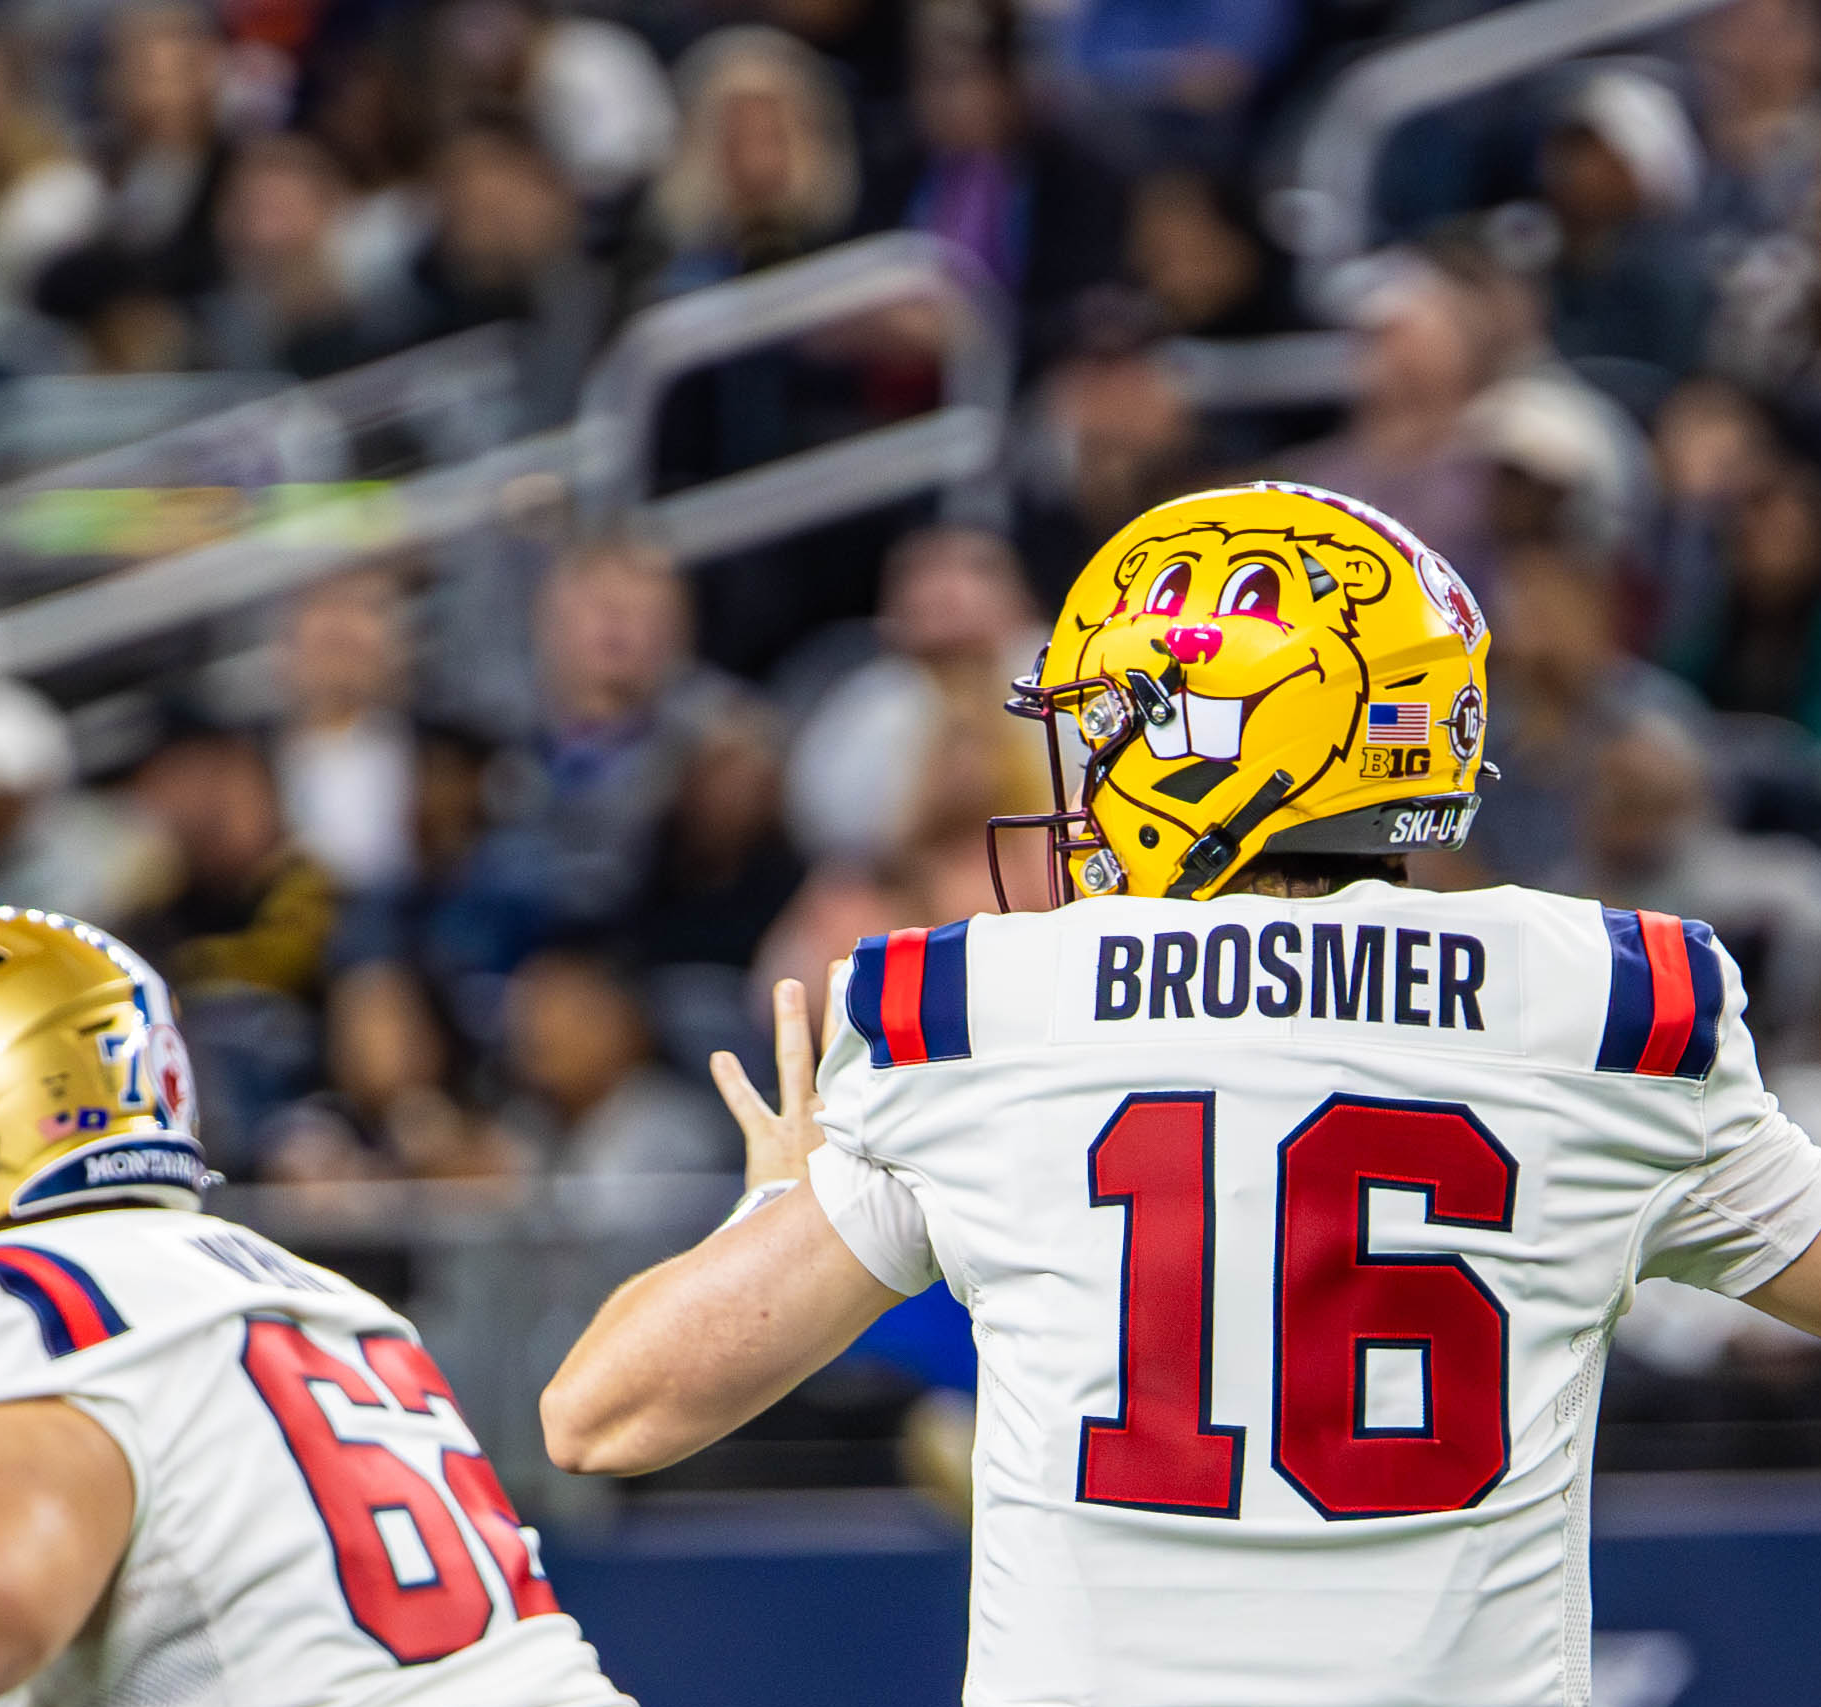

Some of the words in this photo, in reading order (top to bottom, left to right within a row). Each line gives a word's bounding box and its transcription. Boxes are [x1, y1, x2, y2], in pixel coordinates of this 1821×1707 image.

[1094, 920, 1486, 1031] BROSMER
[1075, 1089, 1520, 1522] 16
[239, 1310, 562, 1668] 62
